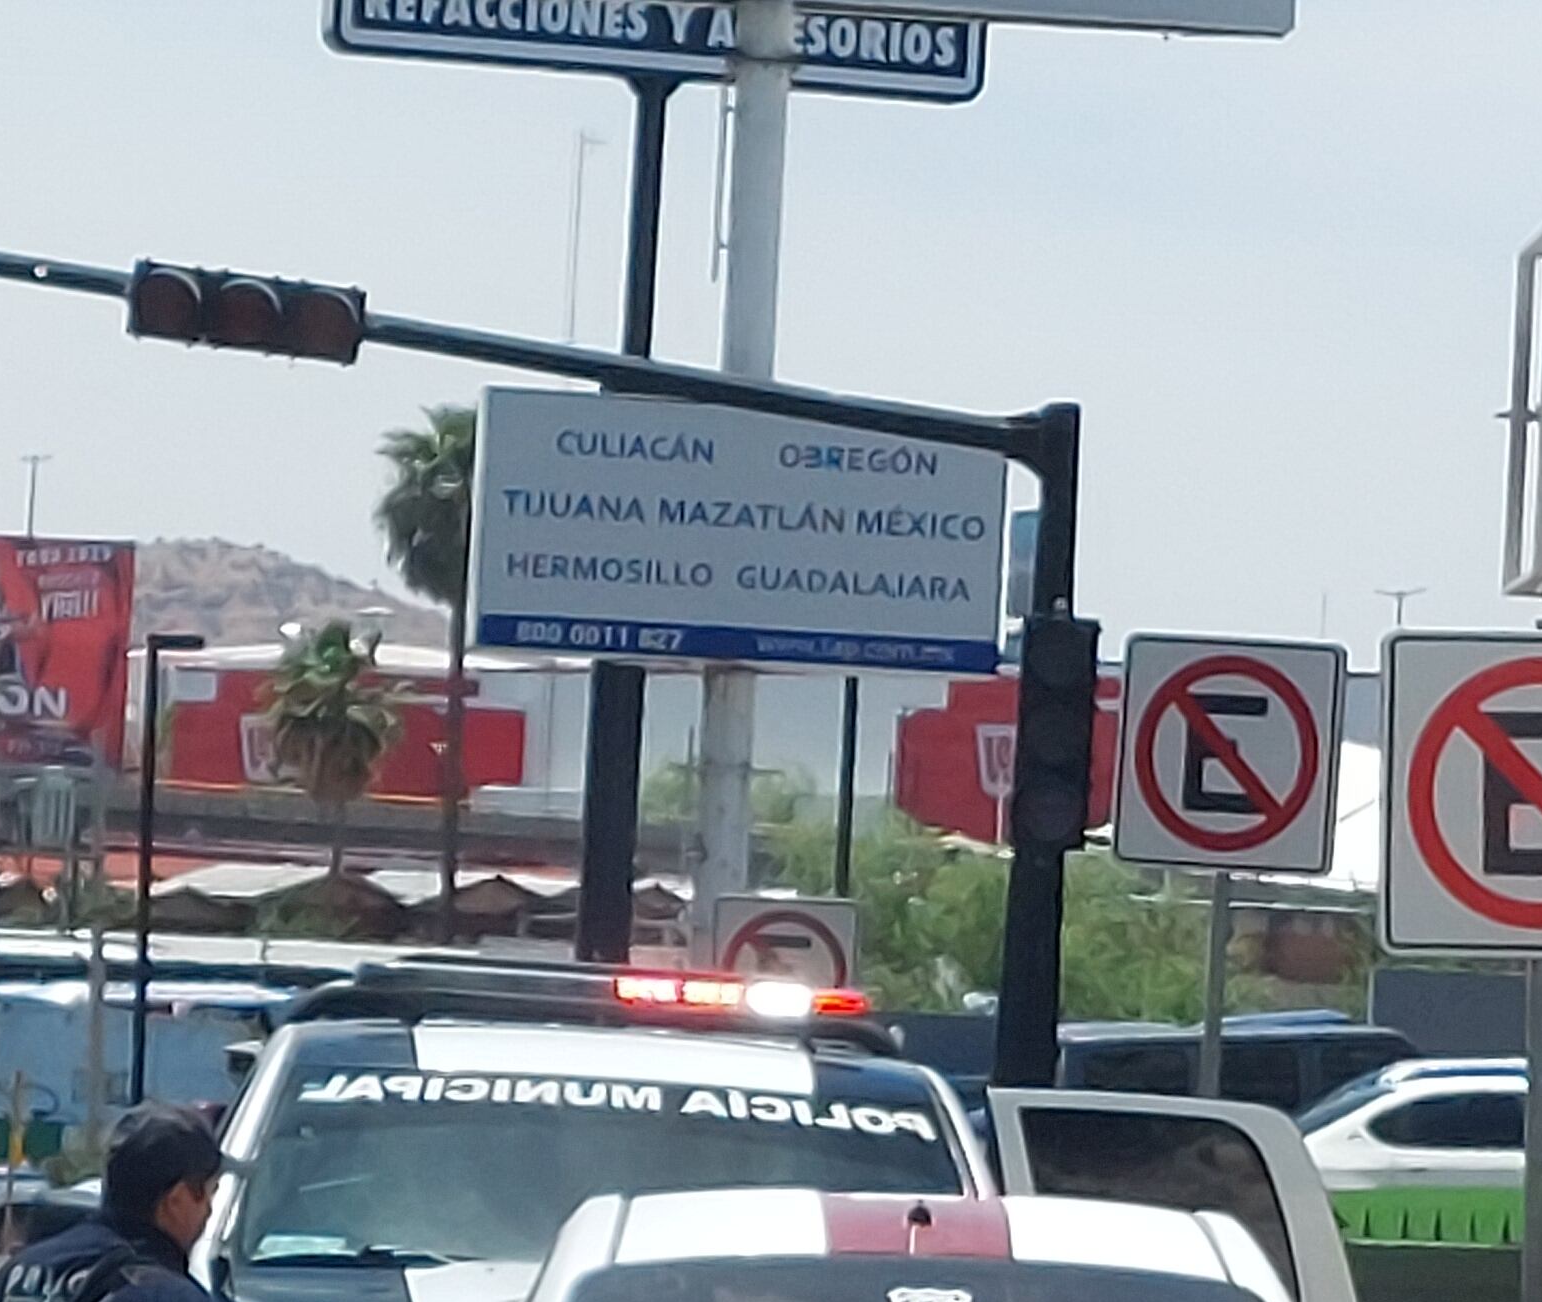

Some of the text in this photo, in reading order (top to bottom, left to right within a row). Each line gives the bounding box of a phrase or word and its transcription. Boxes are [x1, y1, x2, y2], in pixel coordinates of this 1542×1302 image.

[665, 5, 696, 44] Y
[556, 429, 938, 476] CULIACÁN OBREGÓN
[502, 488, 986, 542] TIJUANA MAZATLÁN MÉXICO
[507, 553, 972, 602] HERMOSILLO GUADALAJARA
[569, 623, 628, 648] 0011
[1184, 694, 1269, 814] E
